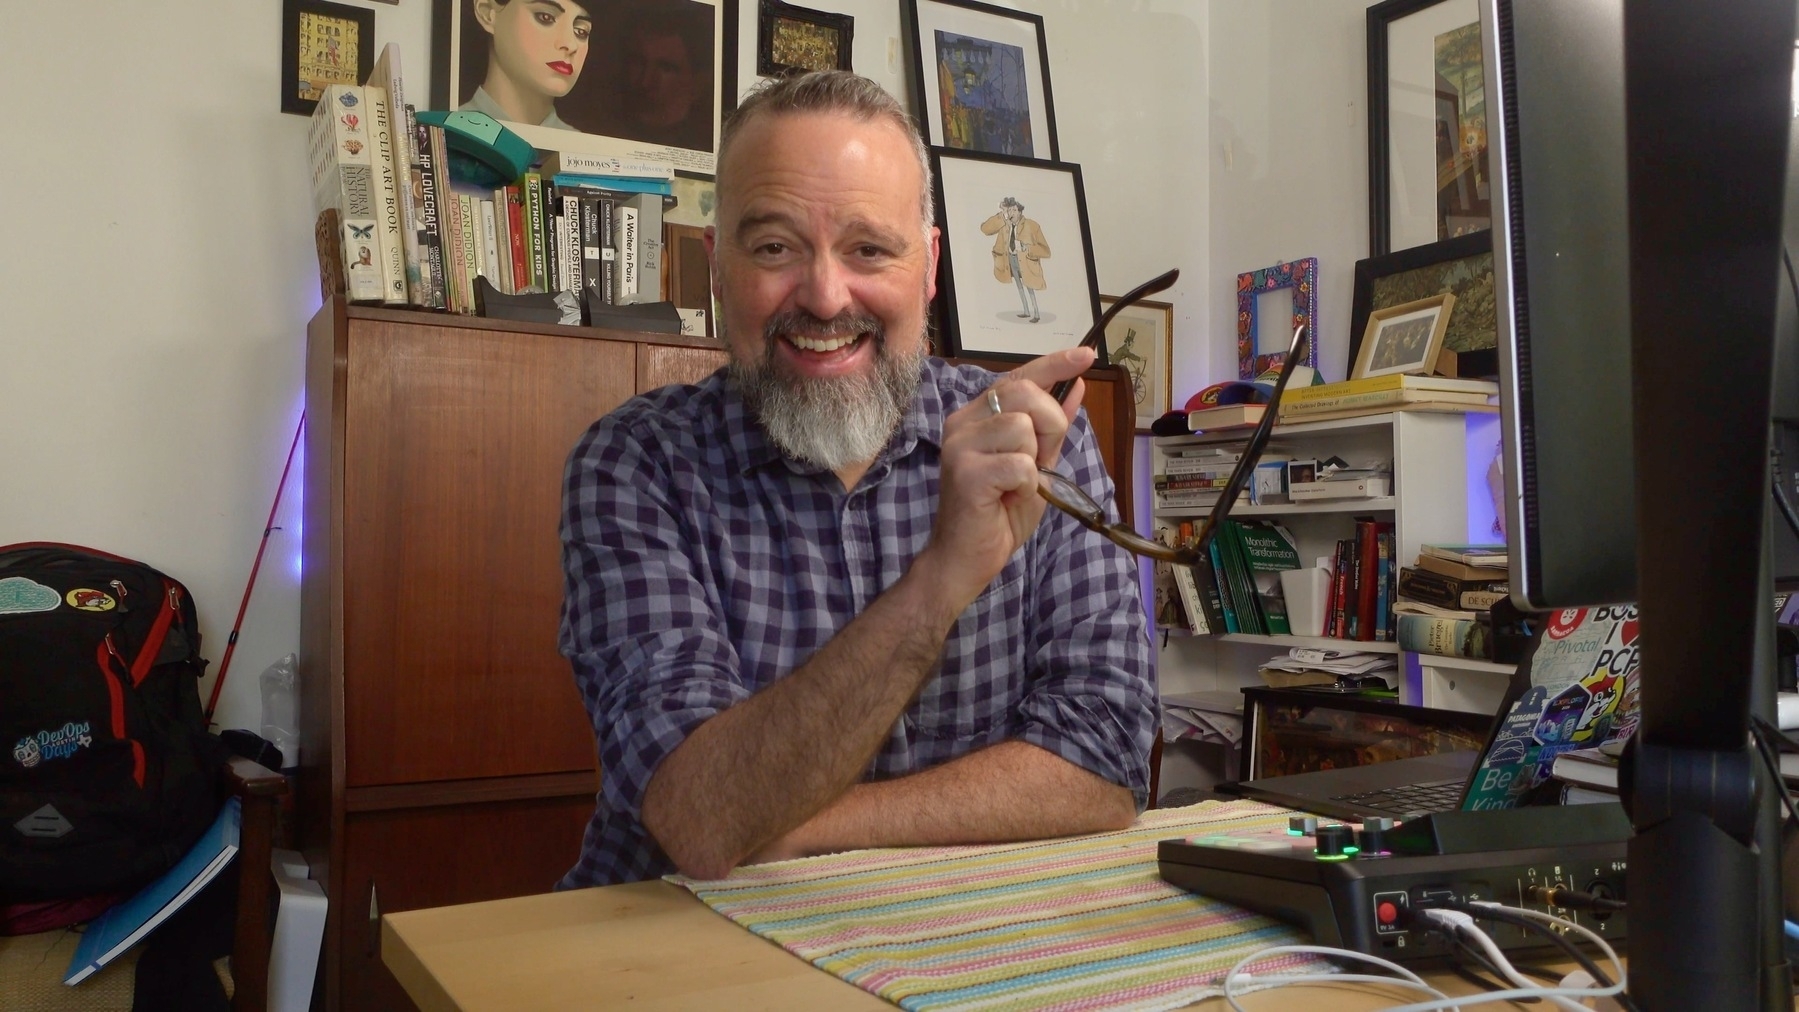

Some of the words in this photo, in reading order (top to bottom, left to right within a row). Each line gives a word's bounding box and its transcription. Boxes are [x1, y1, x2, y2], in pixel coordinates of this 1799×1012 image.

[375, 100, 386, 127] THE
[379, 131, 390, 161] CLIP
[419, 154, 431, 169] HP
[567, 157, 583, 167] jojo
[584, 159, 610, 169] moyes
[346, 166, 360, 217] HISTORY
[357, 168, 369, 216] NATURAL
[382, 166, 394, 193] ART
[385, 197, 397, 234] BOOK
[421, 173, 437, 236] LOVECRAFT
[461, 200, 470, 228] JOAN
[570, 200, 578, 234] CHUCK
[454, 228, 463, 266] DIDION
[626, 223, 634, 250] Waiter
[391, 247, 400, 275] QUINN
[464, 232, 474, 269] DIDION
[626, 262, 634, 283] Paris
[1245, 537, 1278, 548] Monolithic
[1248, 547, 1295, 559] Transformation
[1435, 620, 1444, 654] Bruegel
[1554, 638, 1601, 654] Pivotal
[1605, 622, 1619, 644] I
[1554, 696, 1584, 706] EXPLORE
[1508, 713, 1541, 722] PATAGONIA
[37, 720, 90, 746] DevOps
[42, 741, 78, 761] Days
[1481, 769, 1512, 791] Be
